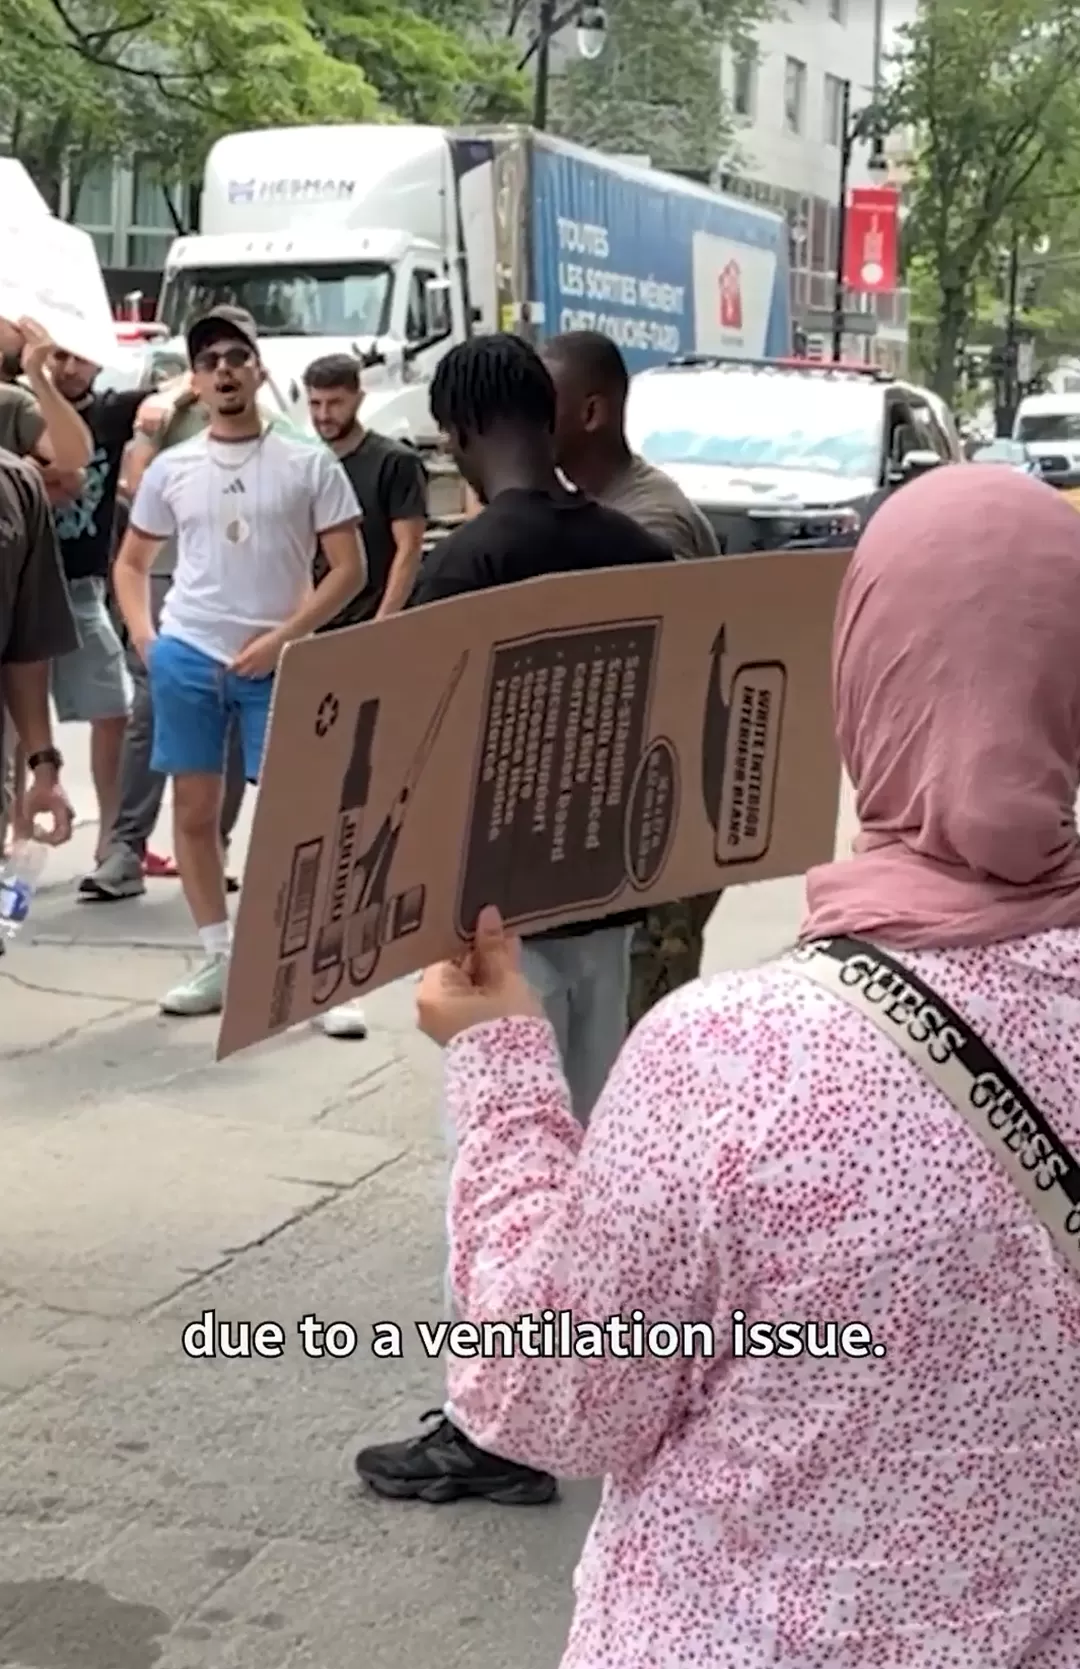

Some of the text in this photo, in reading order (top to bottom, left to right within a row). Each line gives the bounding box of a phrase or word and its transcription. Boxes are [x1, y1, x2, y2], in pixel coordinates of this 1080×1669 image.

[752, 688, 772, 750] WHITE
[726, 785, 745, 847] BLANC
[838, 953, 968, 1064] GUESS
[969, 1071, 1069, 1191] GUESS
